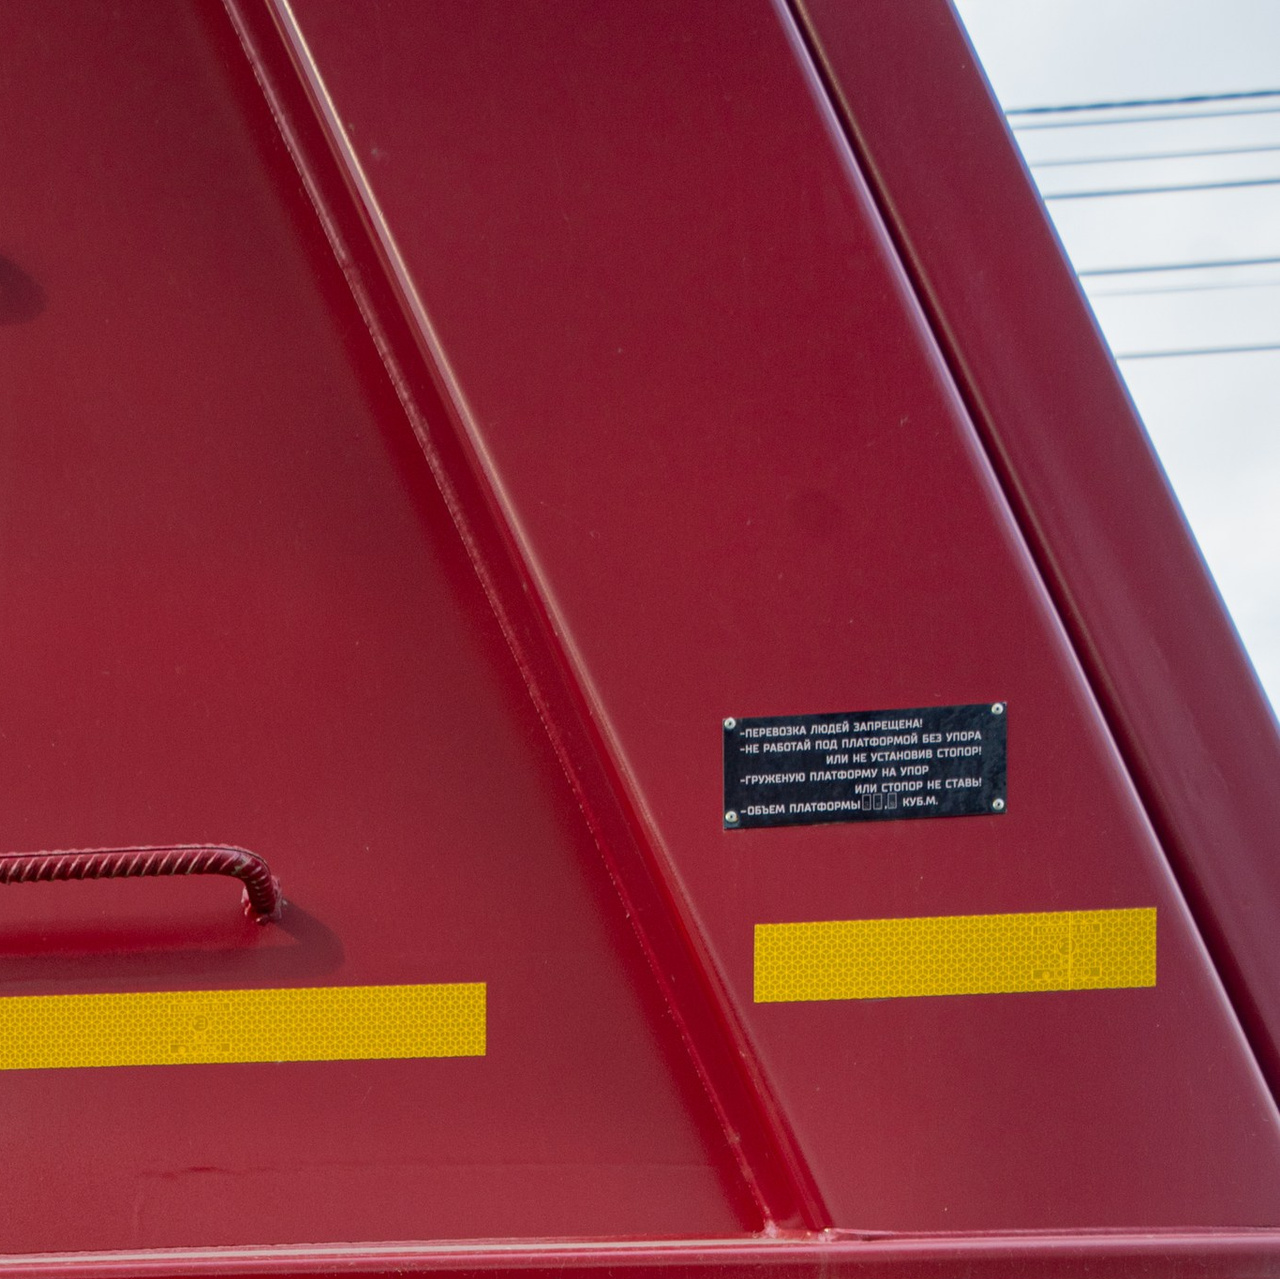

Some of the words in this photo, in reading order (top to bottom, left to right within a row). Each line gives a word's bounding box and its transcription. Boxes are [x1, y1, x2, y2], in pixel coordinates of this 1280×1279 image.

[810, 721, 849, 735] ЛЮДЕЙ
[854, 718, 923, 732] ЗАПРЕЩЕНА!
[763, 739, 811, 753] РАБОТАЙ
[815, 739, 838, 750] ПОД
[842, 733, 918, 748] ПЛАТФОРМОЙ
[922, 733, 942, 743] БЕЗ
[946, 731, 982, 742] УПОРА
[826, 754, 848, 764] ИЛИ
[853, 753, 867, 763] НЕ
[871, 749, 933, 762] УСТАНОВИВ
[937, 746, 982, 758] СТОПОР!
[810, 768, 878, 781] ПЛАТФОРМУ
[882, 767, 896, 777] НА
[900, 765, 929, 776] УПОР
[855, 784, 877, 796] ИЛИ
[881, 781, 923, 794] СТОПОР
[927, 780, 941, 789] НЕ
[945, 777, 982, 788] СТАВЬ!
[789, 800, 860, 813] ПЛАТФОРМЫ
[903, 796, 938, 807] КУБ.М.
